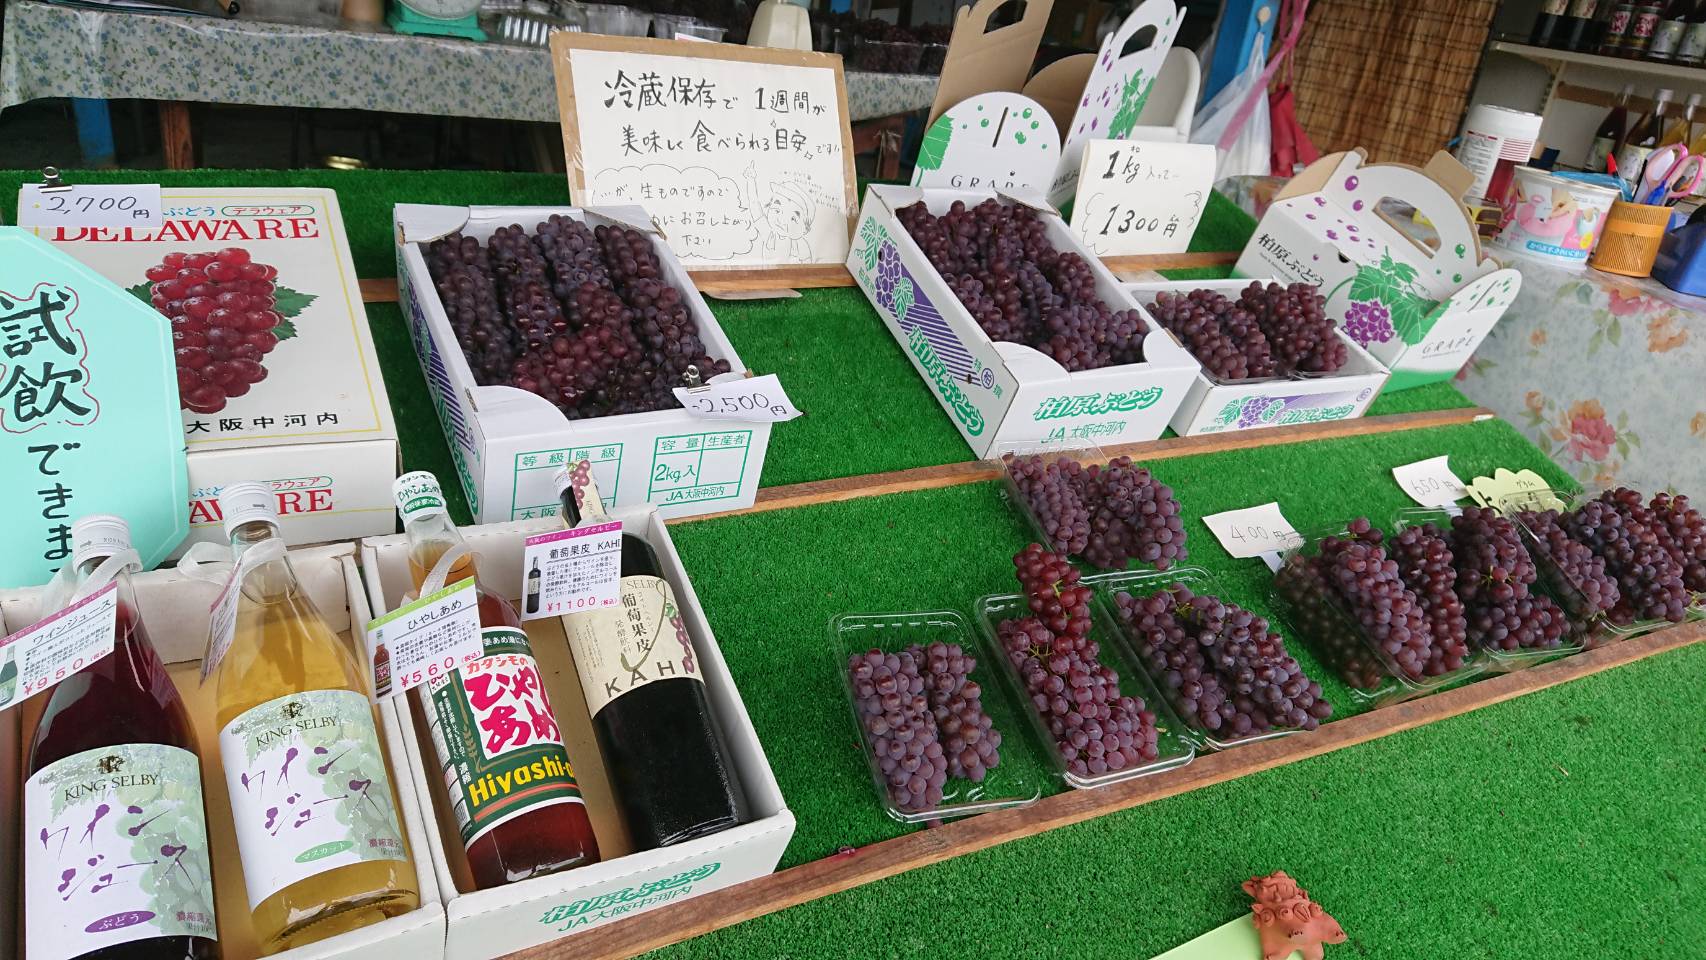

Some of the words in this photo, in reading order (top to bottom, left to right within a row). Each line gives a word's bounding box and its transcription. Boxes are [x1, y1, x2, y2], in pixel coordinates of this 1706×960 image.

[603, 69, 738, 112] 冷蔵保存で
[754, 86, 827, 116] 1週間が
[46, 195, 150, 219] 2,700円
[232, 204, 304, 217] デラウェア
[1257, 233, 1325, 288] 柏原ぶどう
[1421, 335, 1475, 354] GRAPE
[1033, 387, 1164, 422] 柏原ぶどう
[0, 289, 91, 573] 試飲できま
[186, 412, 339, 434] 大阪中河内
[708, 434, 746, 448] 生産者
[271, 476, 321, 490] ラウェア
[33, 599, 111, 645] ワインジュース
[408, 599, 462, 630] ひやしあめ
[622, 593, 652, 653] 葡萄果皮
[400, 656, 454, 688] ¥560
[466, 654, 530, 675] カタシモの
[255, 724, 293, 748] KING
[295, 715, 338, 734] SELBY
[64, 778, 107, 802] KING
[111, 773, 160, 791] SELBY
[98, 912, 142, 932] ぶどう
